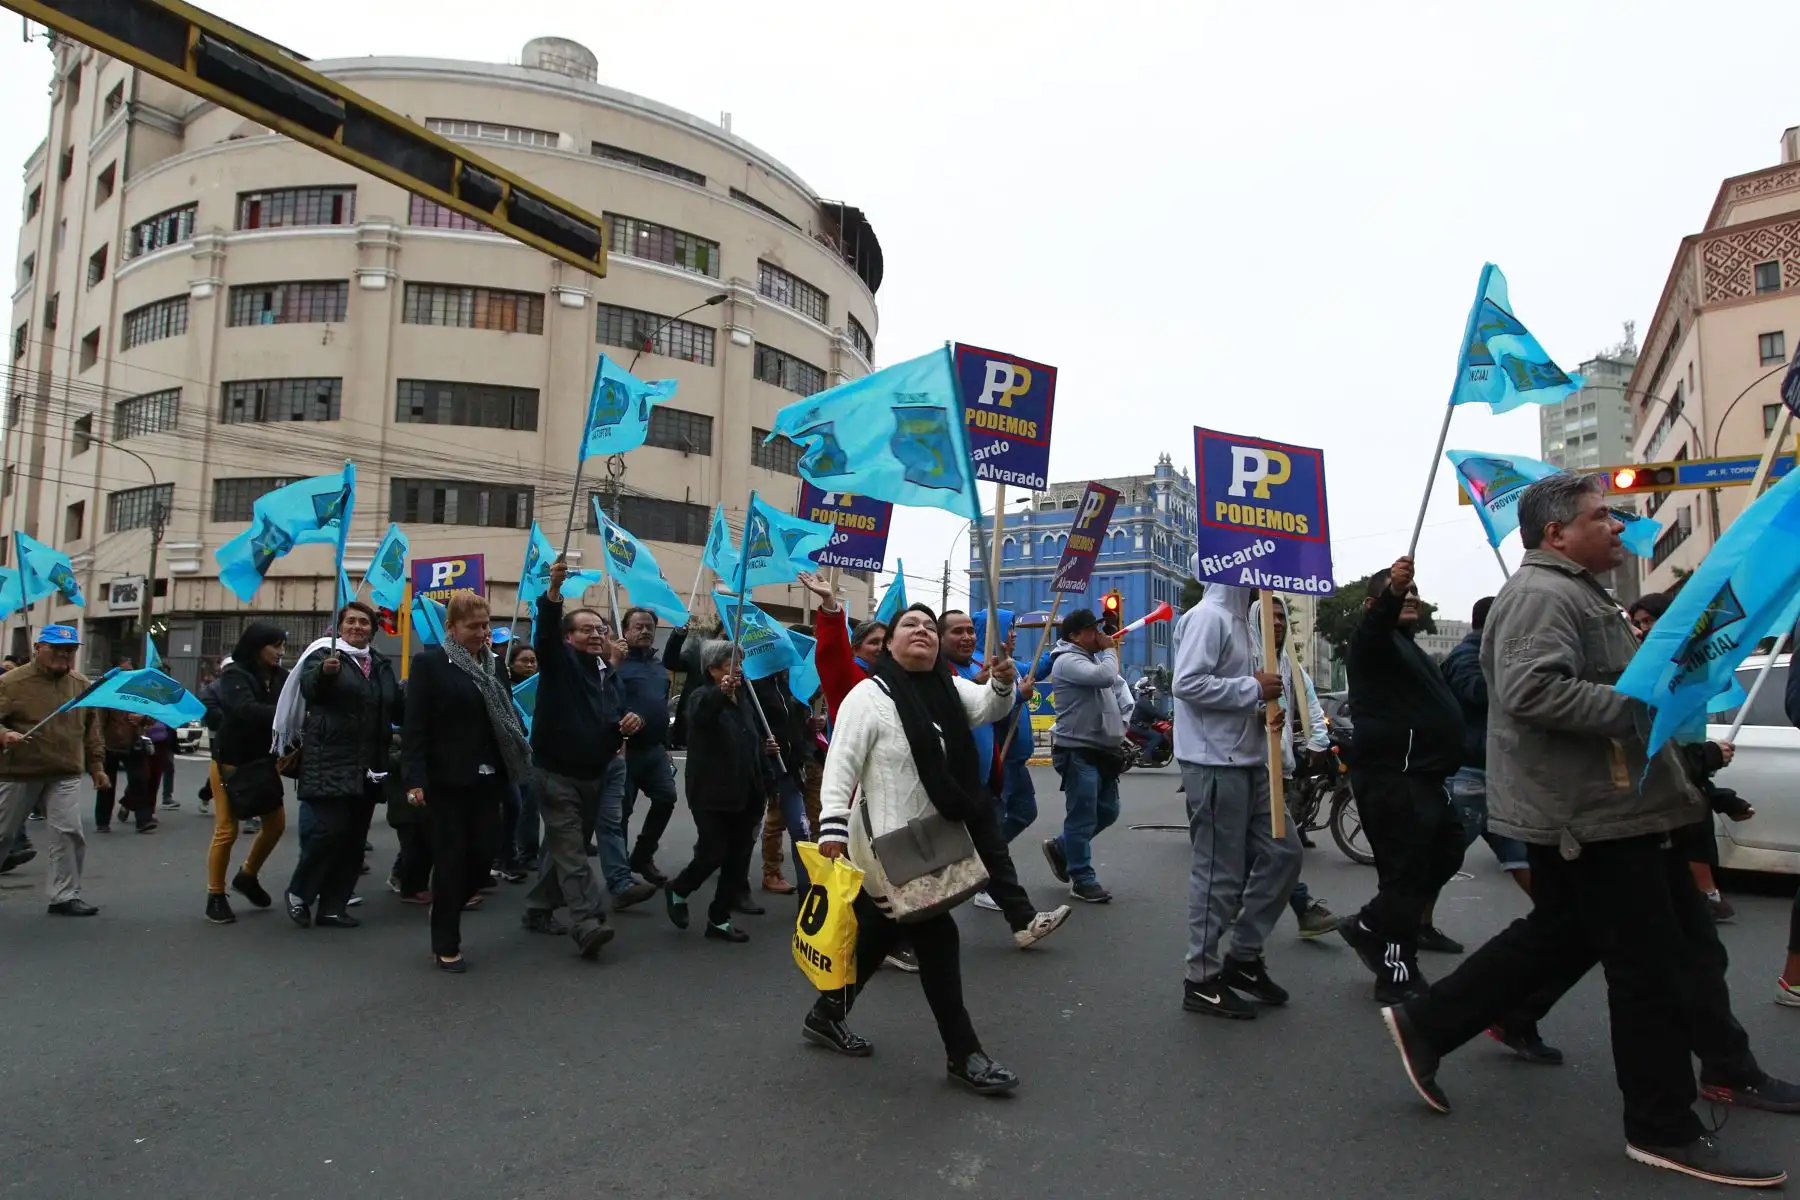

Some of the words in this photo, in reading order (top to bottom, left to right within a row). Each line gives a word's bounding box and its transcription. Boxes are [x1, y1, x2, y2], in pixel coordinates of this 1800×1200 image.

[978, 360, 1032, 408] PP
[965, 408, 1037, 438] PODEMOS
[976, 463, 1045, 488] Alvarado
[1228, 446, 1292, 499] PP
[811, 507, 876, 531] PODEMOS
[1215, 501, 1308, 534] PODEMOS
[818, 550, 881, 570] Alvarado
[1201, 539, 1276, 576] Ricardo
[430, 560, 467, 588] PP
[1057, 577, 1086, 591] Alvarado
[1239, 567, 1332, 592] Alvarado
